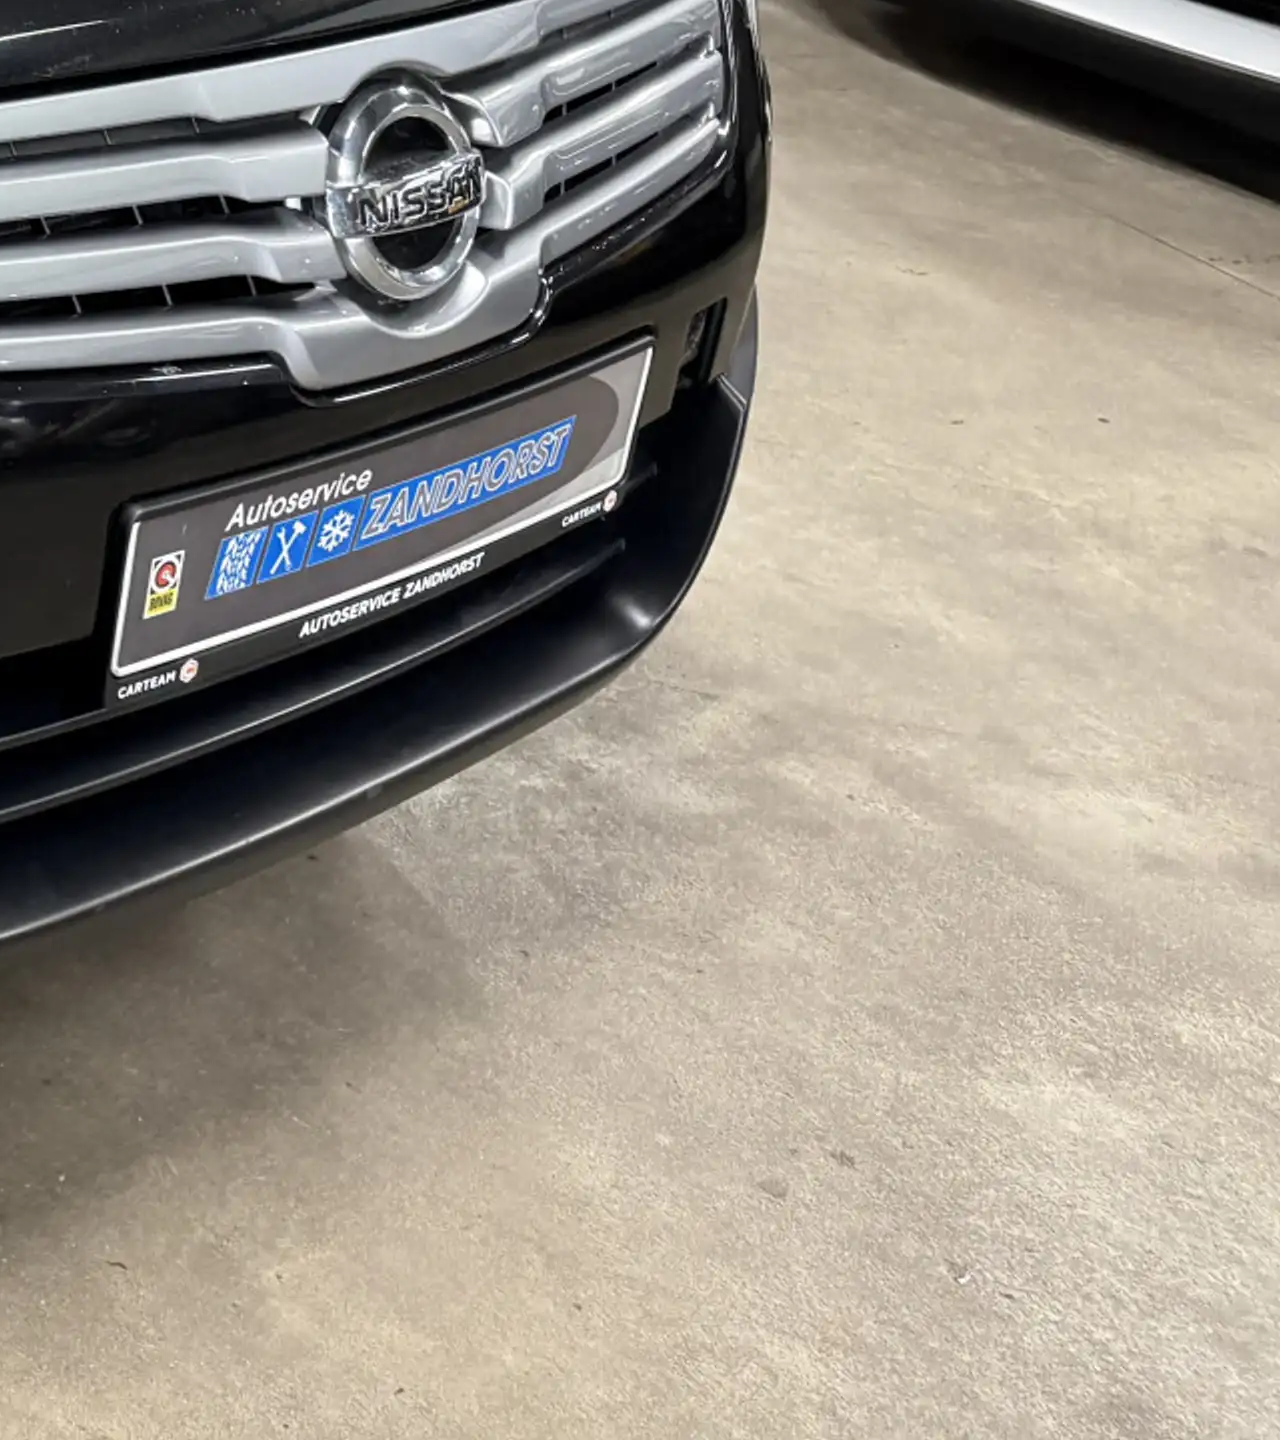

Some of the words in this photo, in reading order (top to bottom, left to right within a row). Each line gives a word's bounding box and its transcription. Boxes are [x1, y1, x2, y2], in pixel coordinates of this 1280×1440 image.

[358, 158, 482, 229] NISSAN
[224, 469, 373, 532] Autoservice
[360, 423, 573, 540] ZANDHORST
[298, 587, 401, 639] AUTOSERVICE
[402, 551, 486, 600] ZANDHORST
[117, 670, 177, 700] CARTEAM
